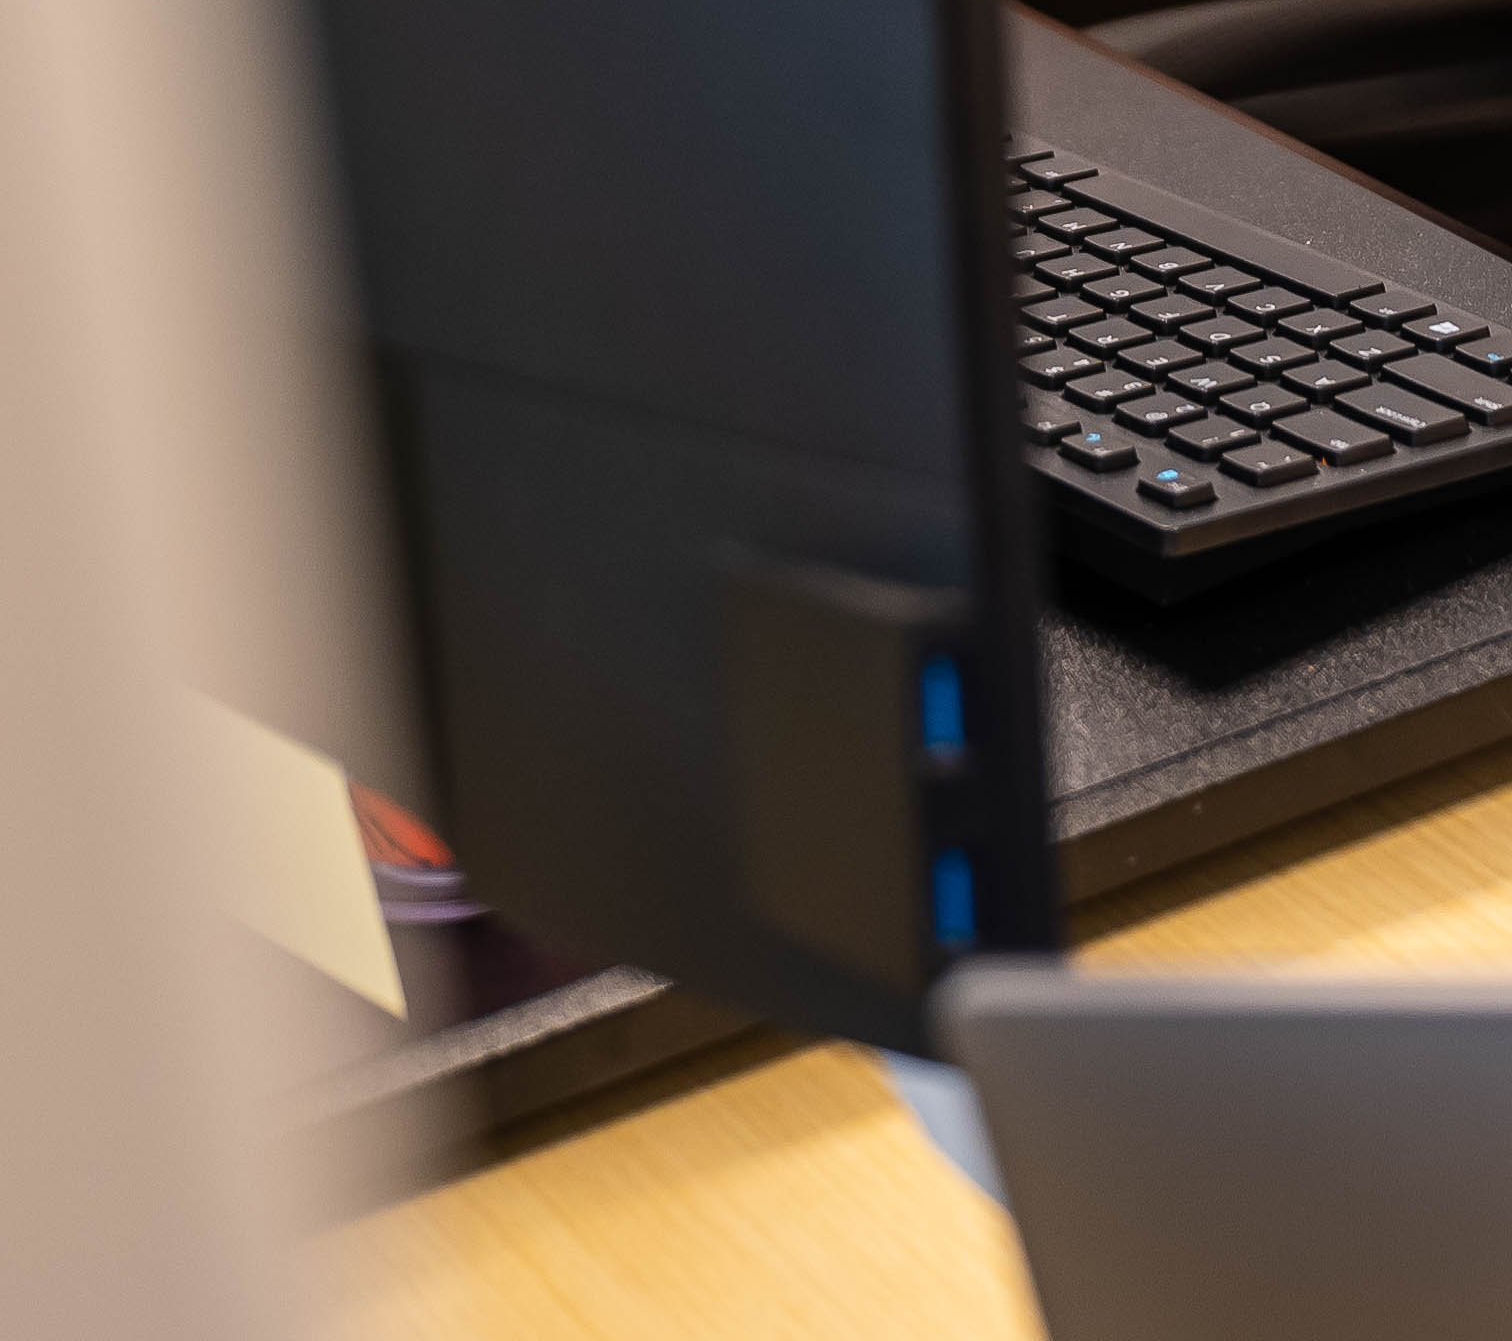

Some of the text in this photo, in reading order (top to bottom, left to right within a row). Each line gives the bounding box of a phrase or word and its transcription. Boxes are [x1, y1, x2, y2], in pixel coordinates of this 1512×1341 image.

[1109, 242, 1133, 250] N
[1158, 262, 1179, 270] B
[1061, 268, 1085, 277] H
[1205, 283, 1225, 291] V
[1109, 289, 1130, 298] G
[1255, 303, 1276, 312] C
[1046, 314, 1067, 322] T
[1158, 312, 1180, 320] F
[1306, 324, 1330, 334] X
[1097, 335, 1119, 345] R
[1209, 333, 1232, 341] D
[1358, 347, 1382, 357] Z
[1146, 356, 1169, 366] E
[1259, 355, 1282, 363] S
[1190, 377, 1218, 389] W
[1315, 376, 1336, 386] A
[1249, 401, 1271, 411] Q
